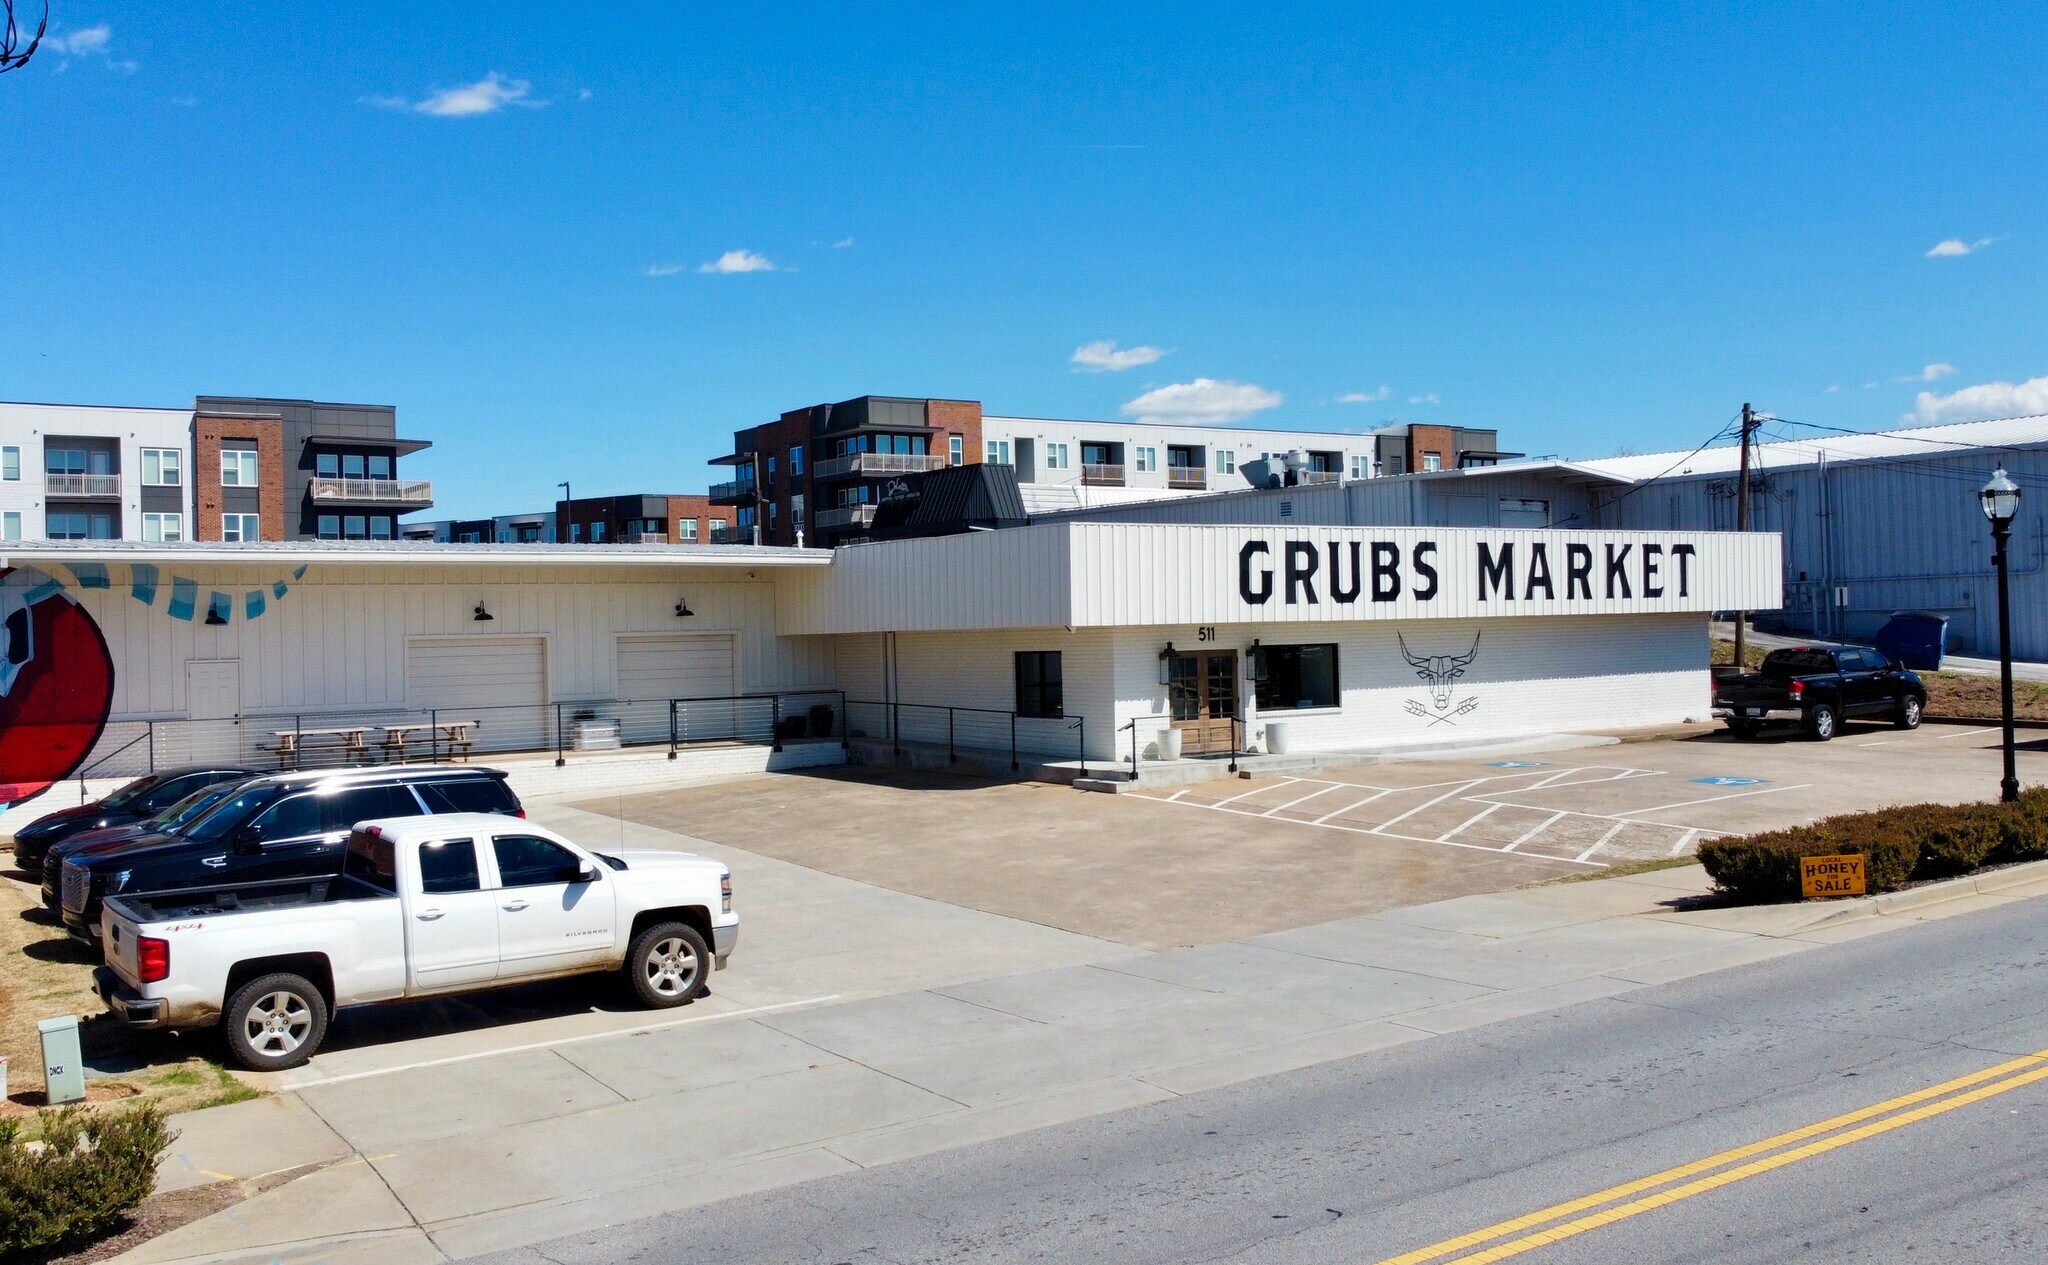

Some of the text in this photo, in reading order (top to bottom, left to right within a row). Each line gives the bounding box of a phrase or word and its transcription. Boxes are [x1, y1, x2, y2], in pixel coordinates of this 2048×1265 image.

[1238, 540, 1697, 605] GRUBS MARKET
[1198, 626, 1215, 642] 511
[1805, 862, 1859, 878] HONEY
[1815, 877, 1851, 892] SALE
[565, 928, 608, 937] SILVERADO
